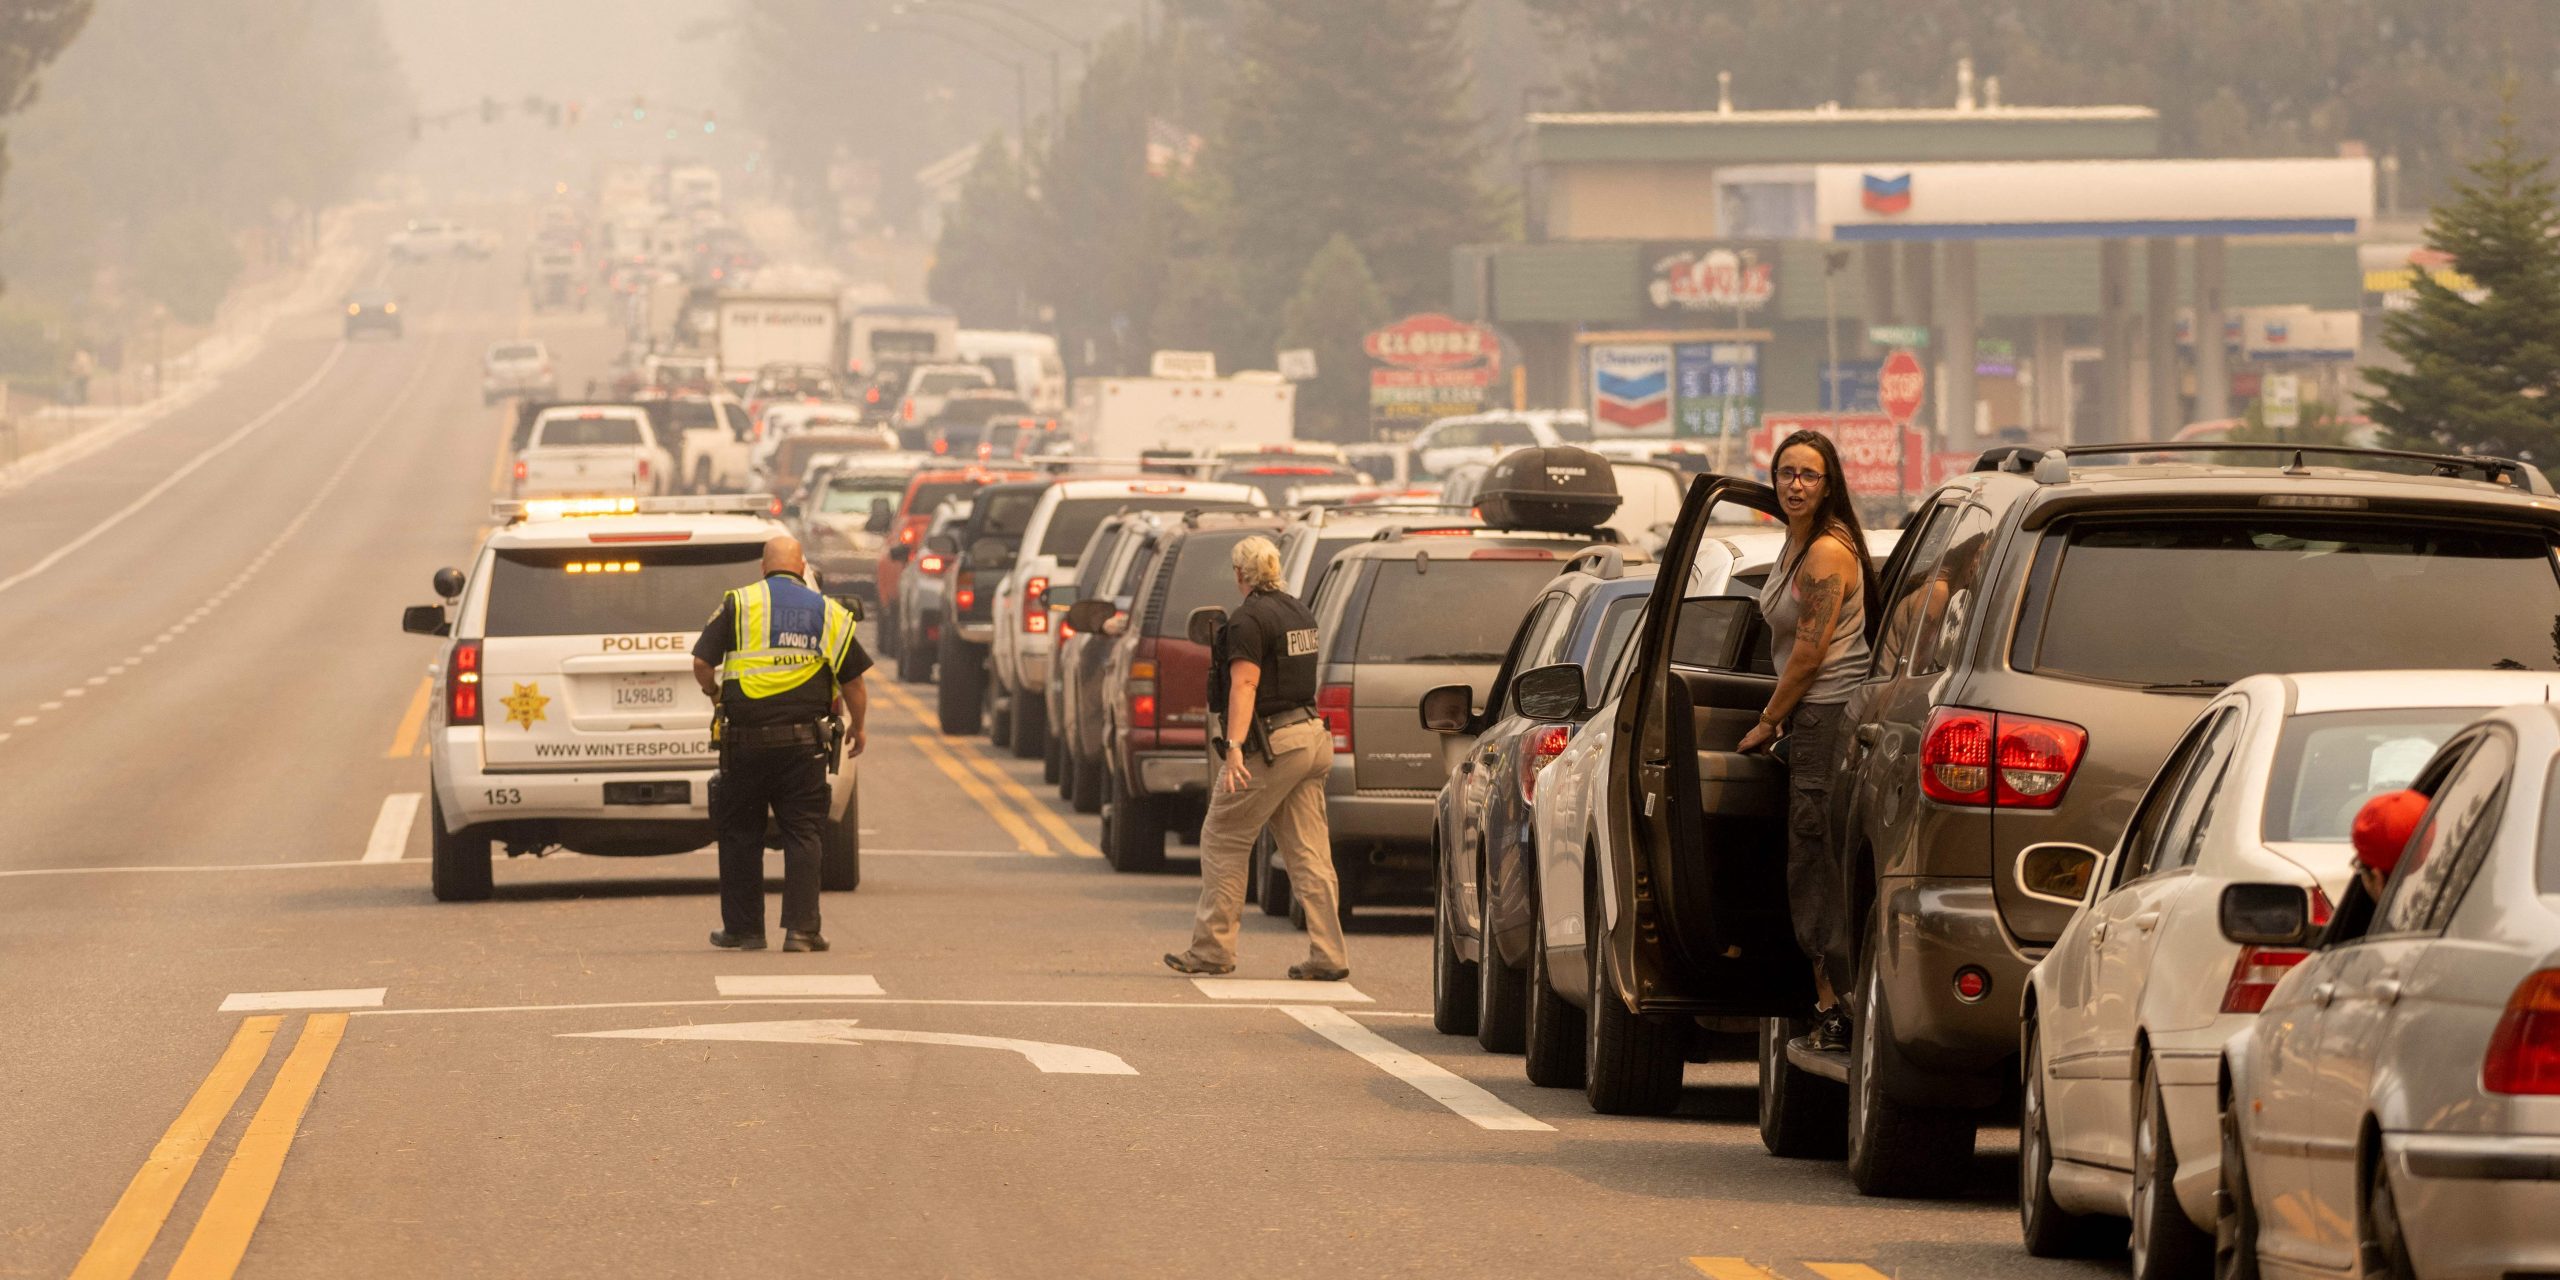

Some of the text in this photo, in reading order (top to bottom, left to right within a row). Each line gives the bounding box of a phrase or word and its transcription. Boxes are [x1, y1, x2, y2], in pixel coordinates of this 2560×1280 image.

[1596, 350, 1668, 366] Chevron
[1881, 373, 1923, 401] STOP
[602, 635, 685, 651] POLICE
[778, 631, 808, 649] AVOID
[617, 687, 673, 704] 1498483
[484, 788, 522, 805] 153
